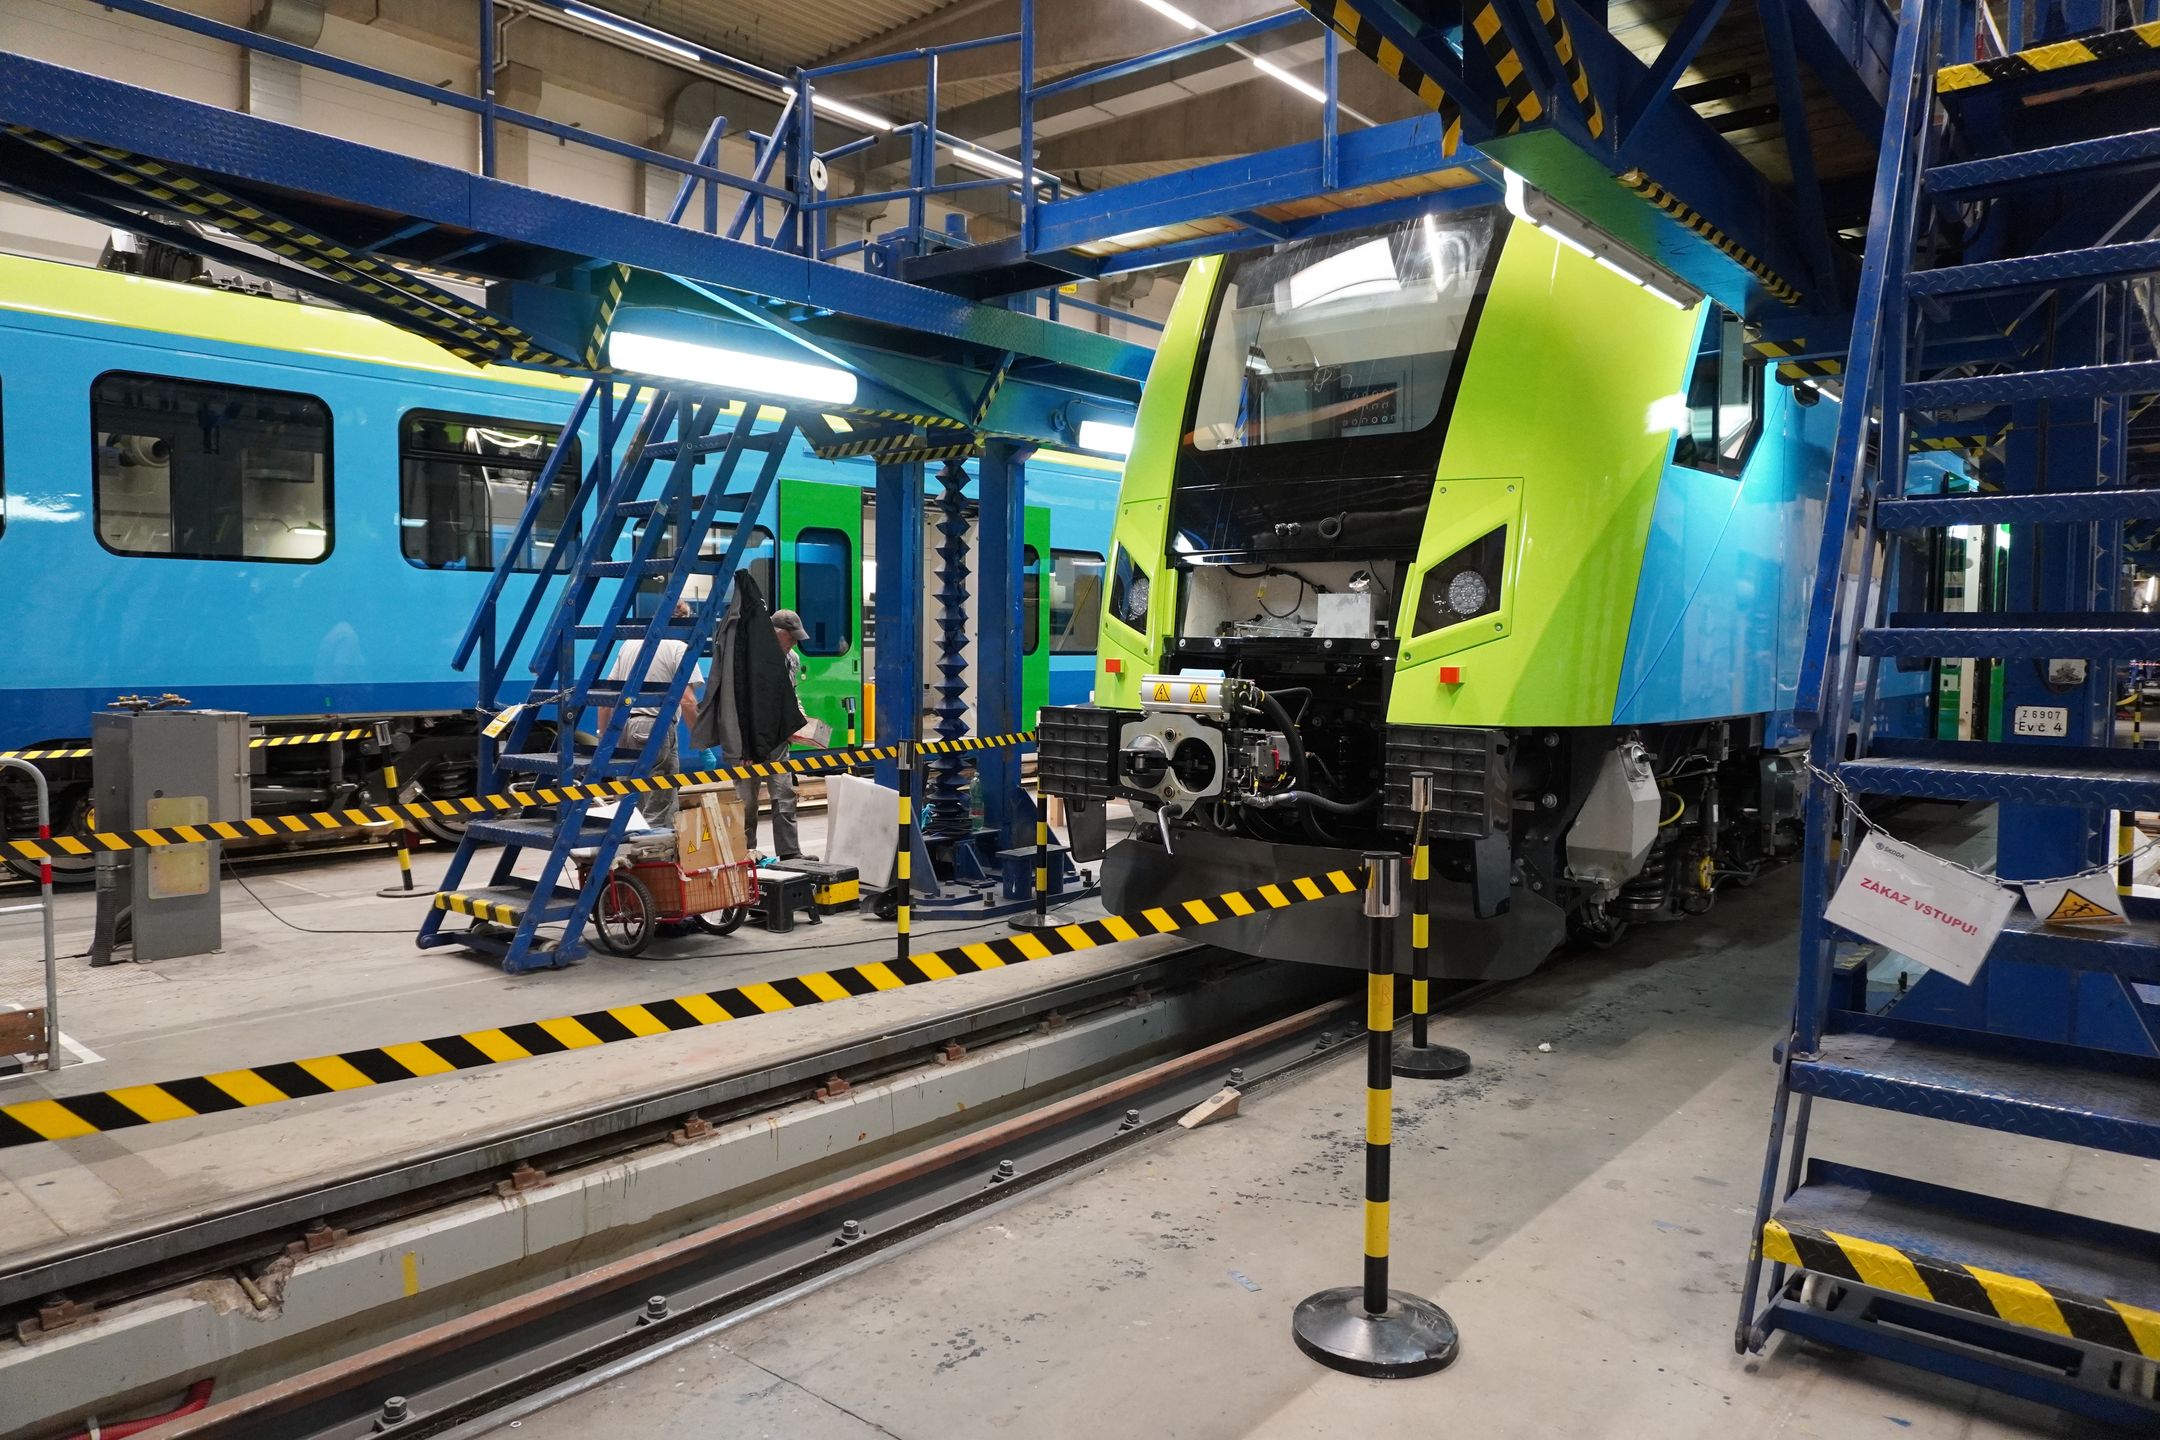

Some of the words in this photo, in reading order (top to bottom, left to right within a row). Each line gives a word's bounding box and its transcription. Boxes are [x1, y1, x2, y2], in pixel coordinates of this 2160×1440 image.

[2022, 710, 2028, 718] Z
[2032, 710, 2061, 720] 6907
[2053, 722, 2062, 732] 4
[1860, 877, 1912, 906] ZÁKAZ
[1914, 900, 1978, 936] VSTUPU!
